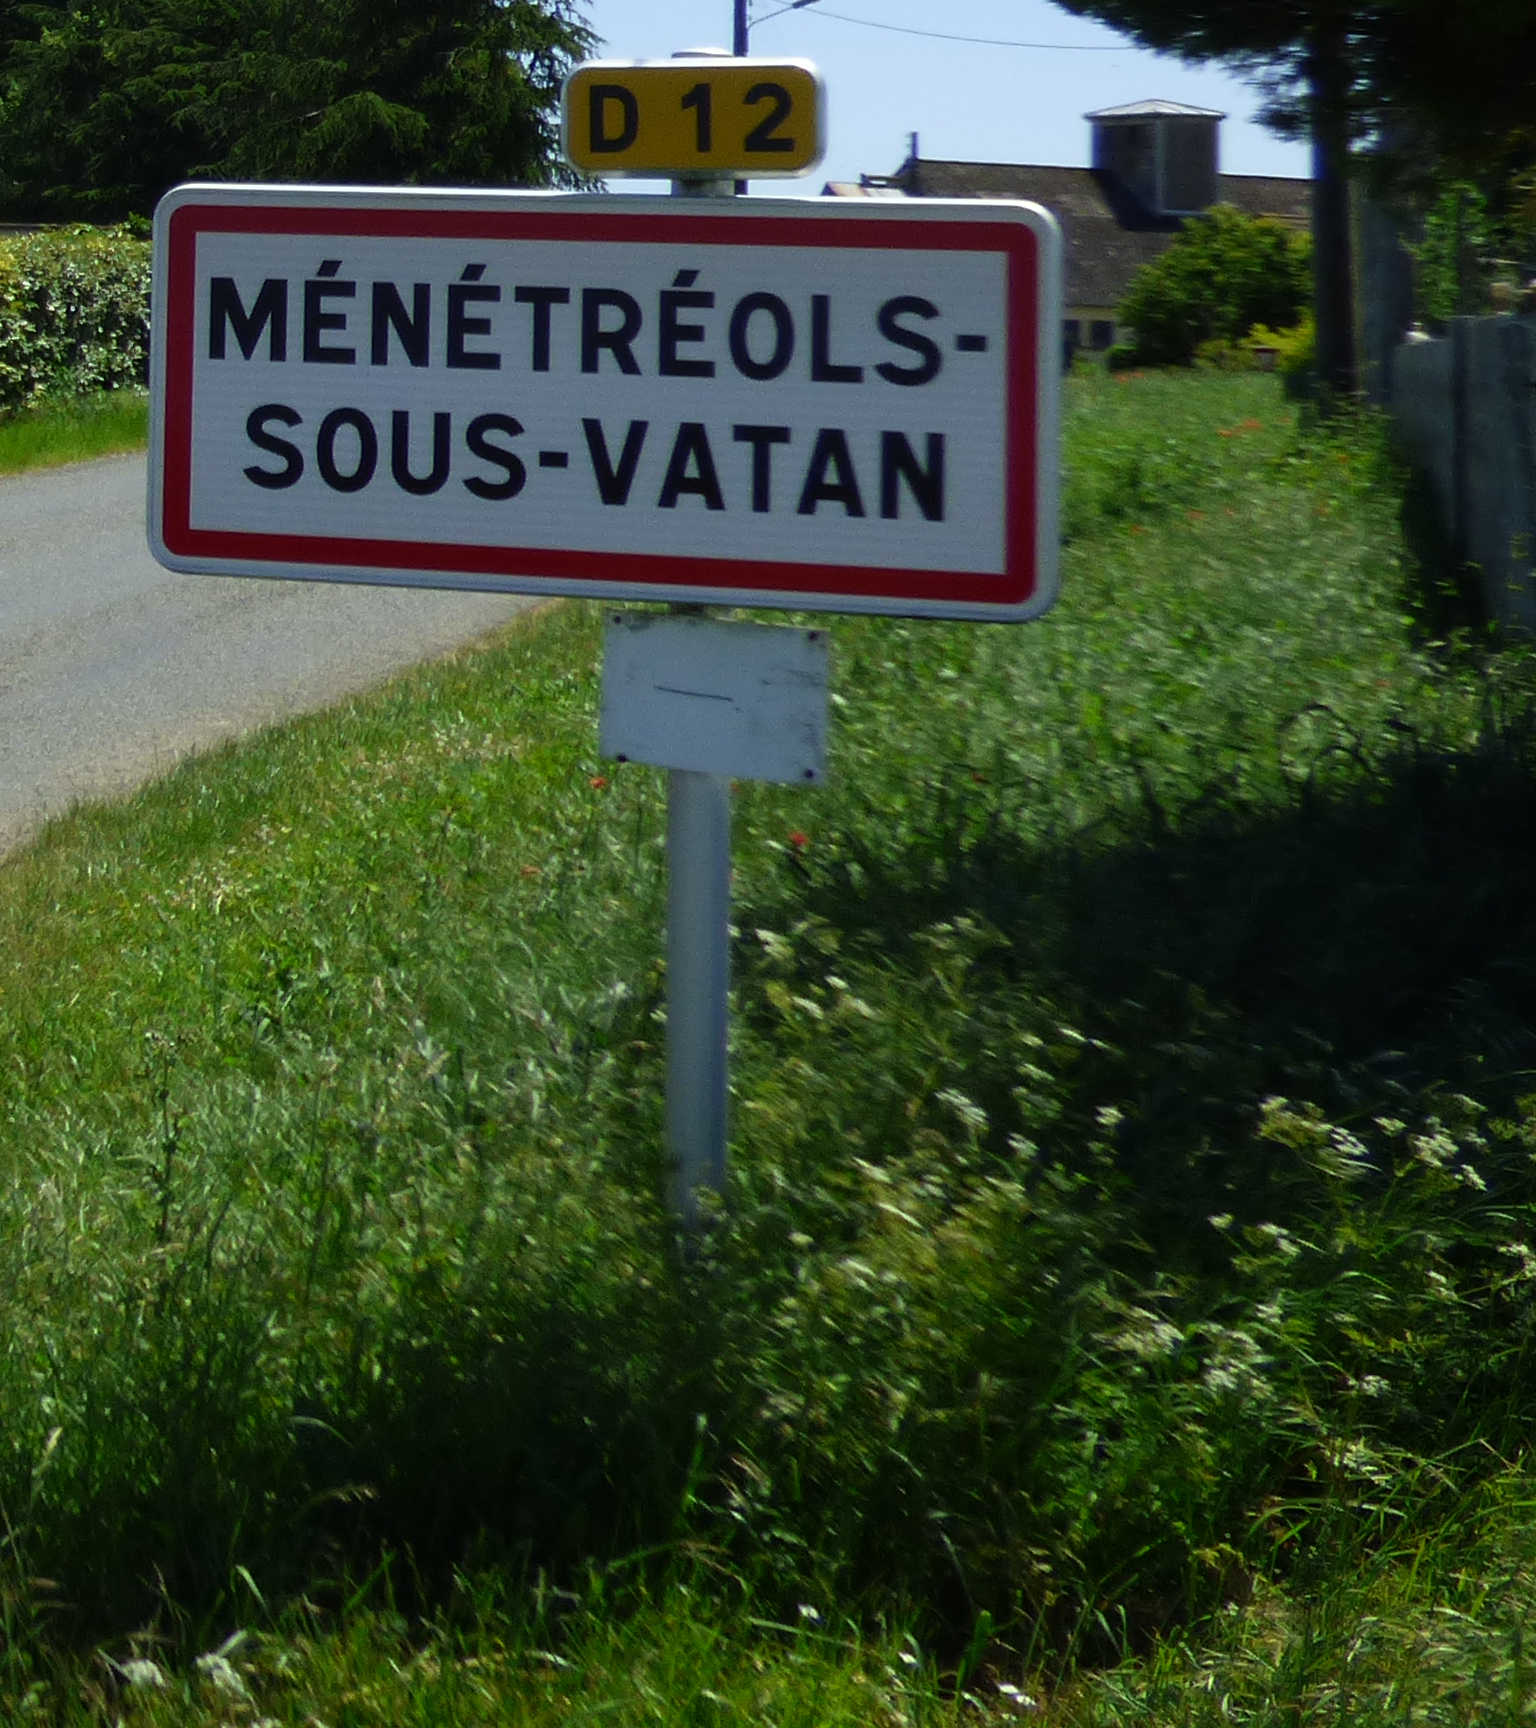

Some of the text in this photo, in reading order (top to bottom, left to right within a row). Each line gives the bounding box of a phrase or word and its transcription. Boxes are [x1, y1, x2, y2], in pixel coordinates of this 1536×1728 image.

[588, 82, 796, 154] D 12
[208, 259, 988, 387] MÉNÉTRÉOLS-
[243, 403, 946, 522] SOUS-VATAN
